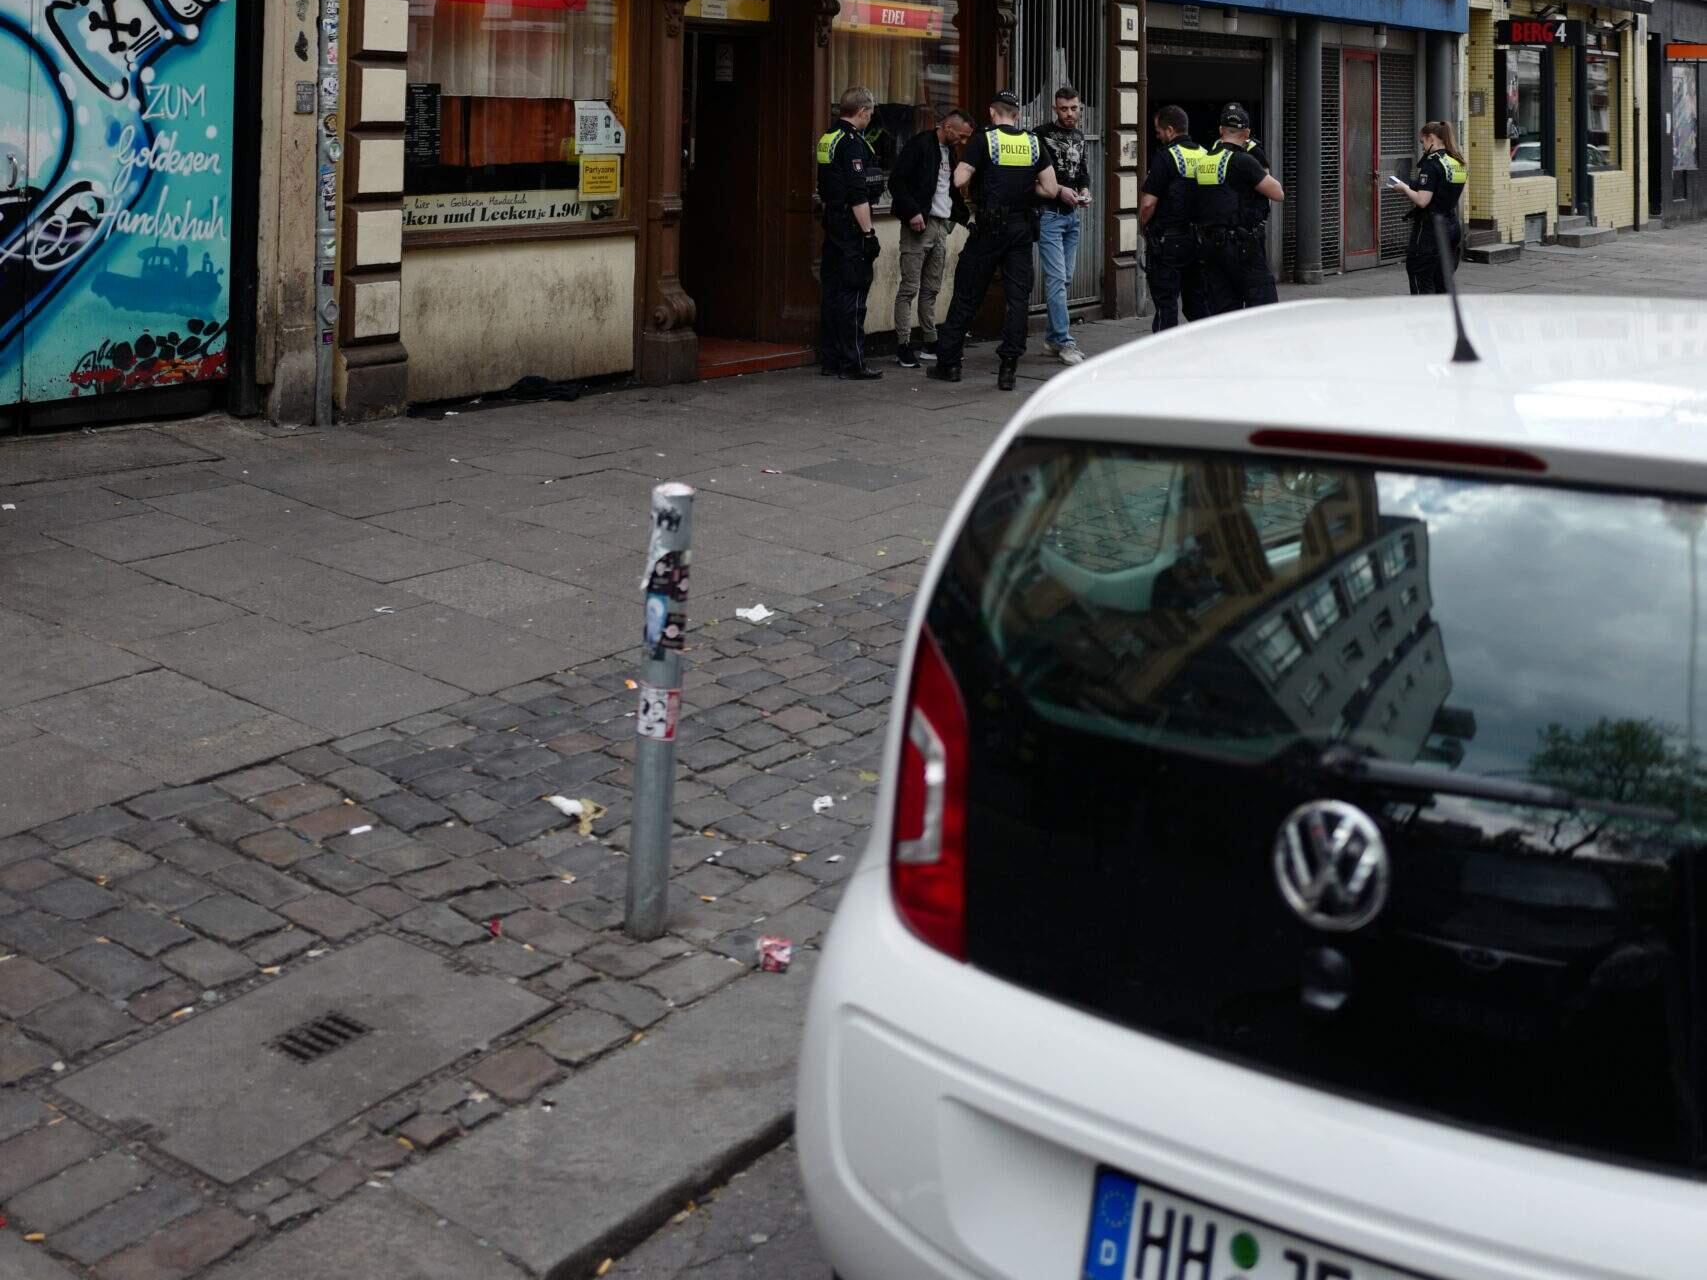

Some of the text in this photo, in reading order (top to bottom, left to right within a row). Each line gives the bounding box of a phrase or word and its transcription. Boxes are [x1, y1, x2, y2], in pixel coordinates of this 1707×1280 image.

[881, 8, 906, 25] EDEL
[1511, 20, 1567, 43] BERG 4
[141, 83, 206, 120] ZUM
[1001, 144, 1030, 155] POLIZEI
[97, 184, 227, 241] Handschuh
[443, 207, 476, 224] und
[480, 205, 537, 222] Lecken
[1101, 1239, 1117, 1267] D
